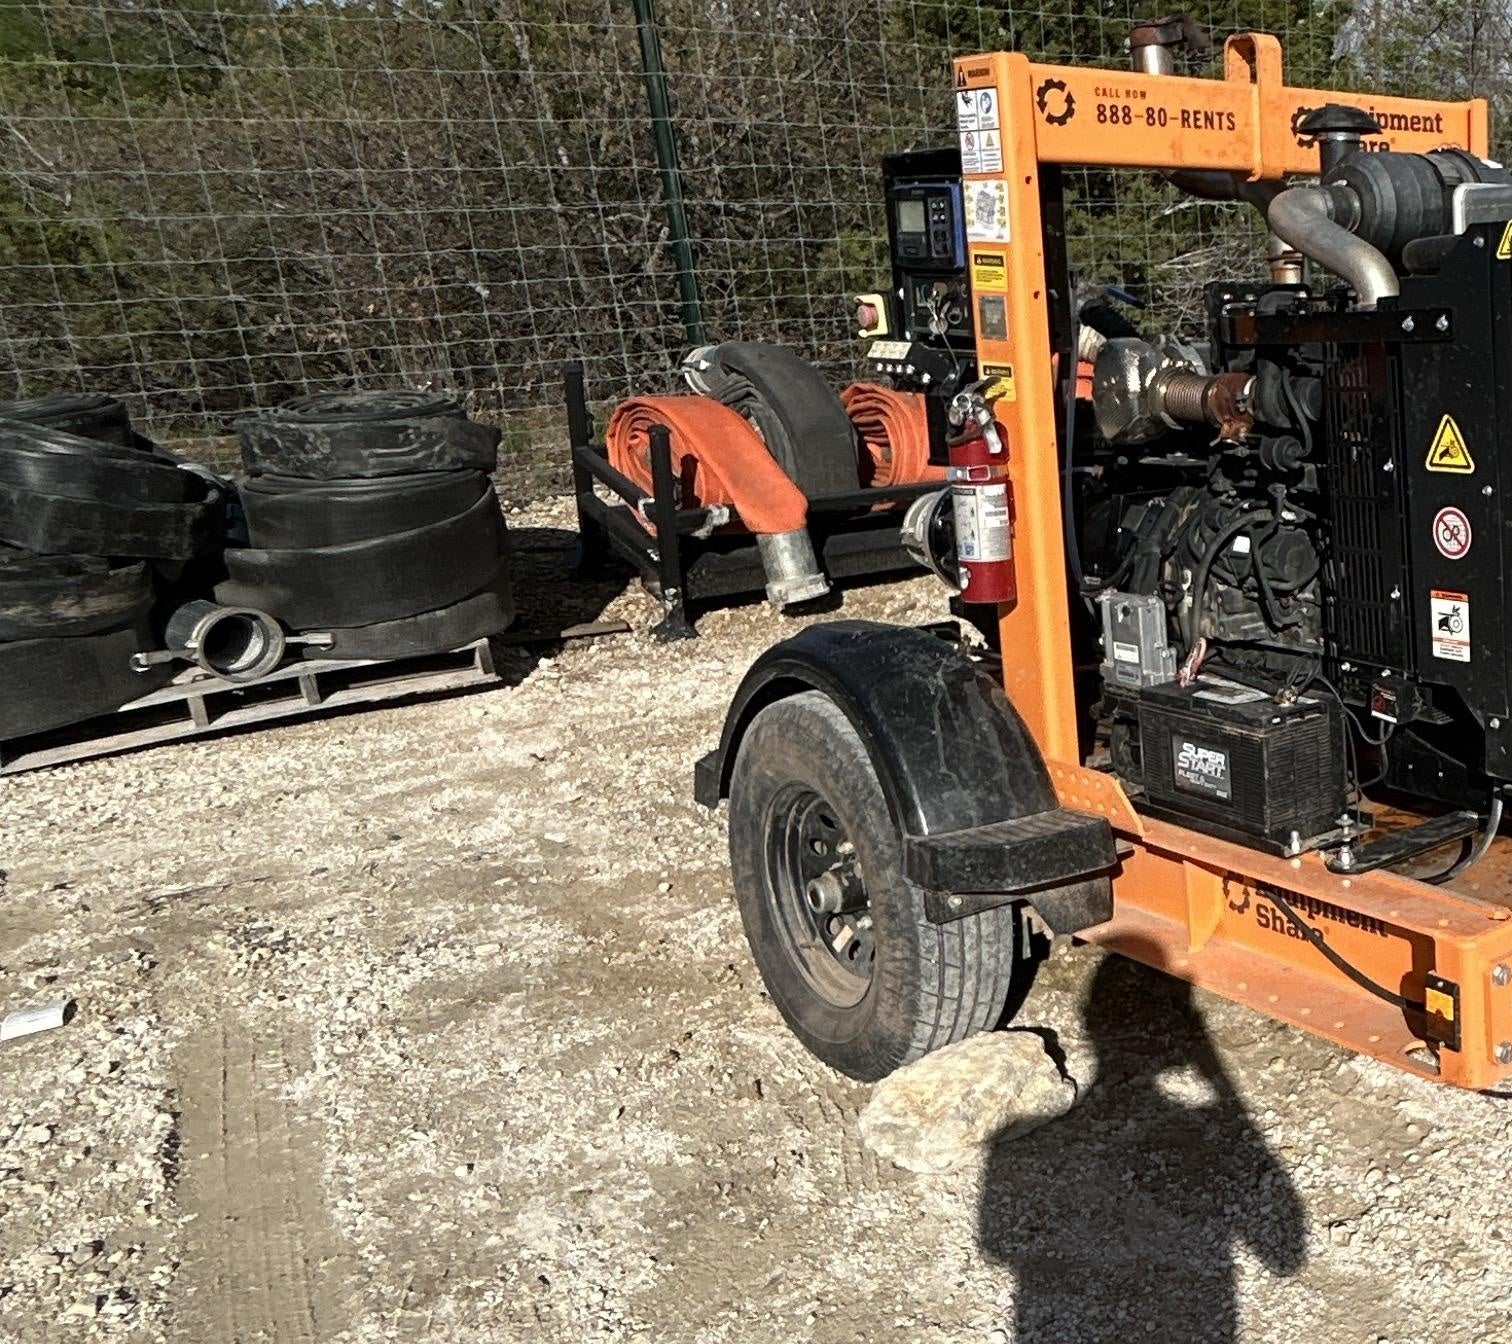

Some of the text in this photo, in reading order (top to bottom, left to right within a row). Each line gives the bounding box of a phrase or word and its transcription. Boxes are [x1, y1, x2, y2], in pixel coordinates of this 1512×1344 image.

[1094, 86, 1147, 100] CALL NOW
[1096, 103, 1236, 132] 888-80-RENTS
[1368, 106, 1443, 133] ipment
[1358, 138, 1391, 153] are
[1178, 751, 1226, 777] START
[1182, 742, 1225, 766] SUPER
[1256, 880, 1389, 938] uipment
